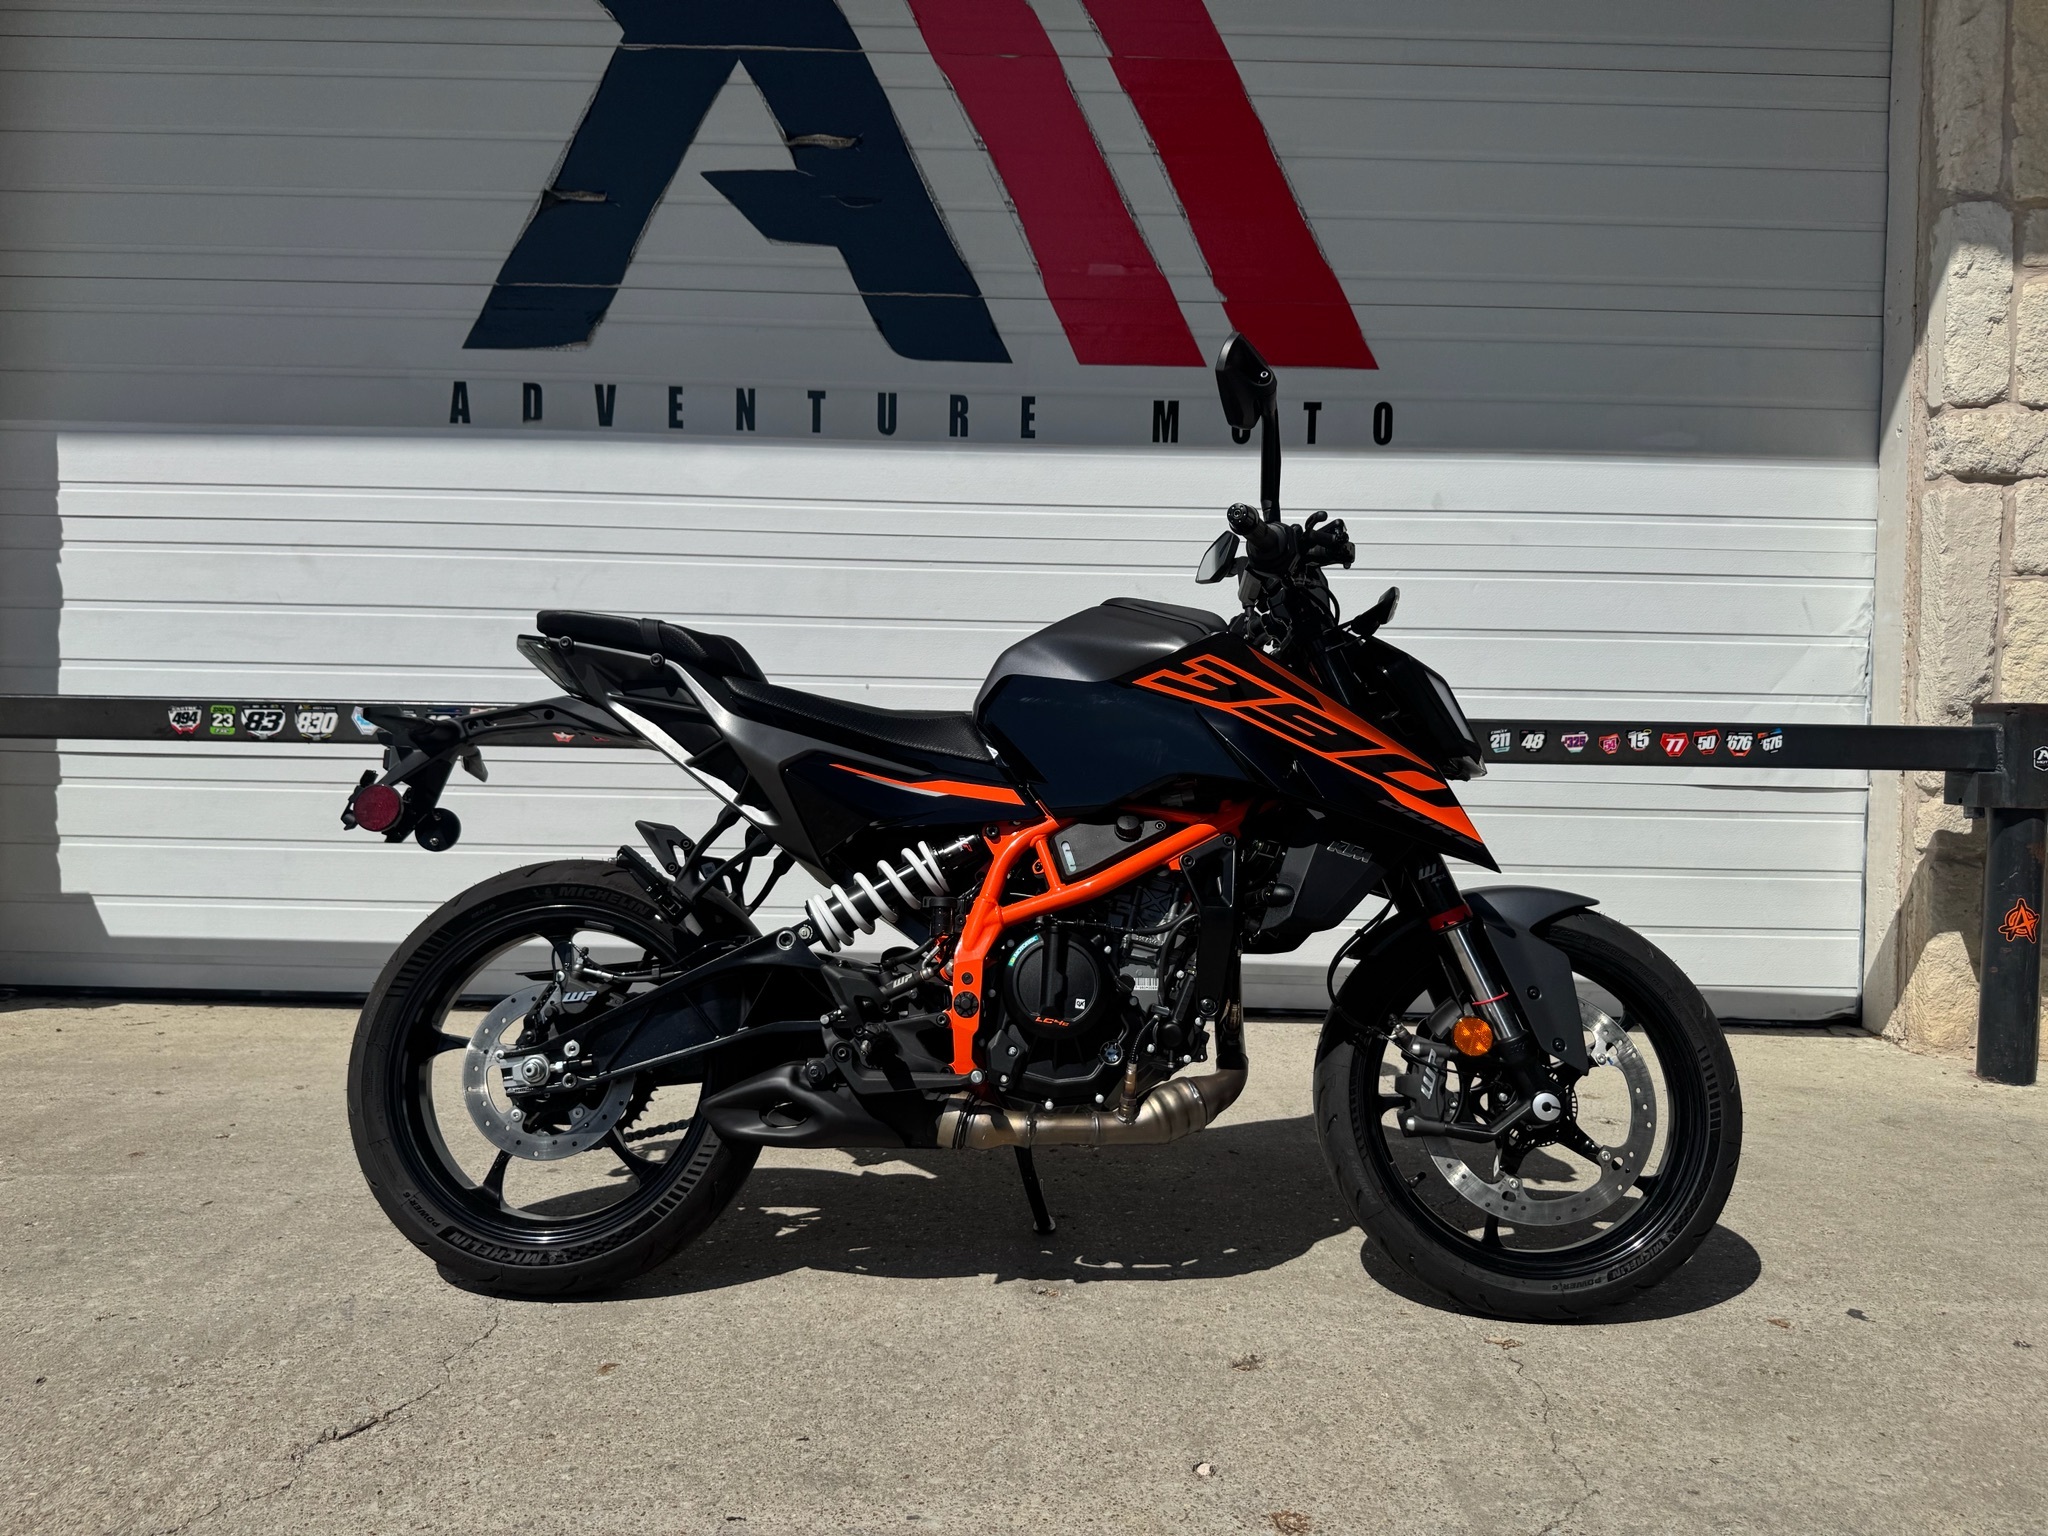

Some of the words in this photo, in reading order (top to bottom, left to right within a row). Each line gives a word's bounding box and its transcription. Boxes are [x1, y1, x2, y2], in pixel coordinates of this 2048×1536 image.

[449, 381, 1038, 440] ADVENTURE
[172, 711, 198, 725] 494
[212, 713, 234, 727] 23
[244, 711, 283, 731] 83
[299, 712, 339, 733] 830
[1490, 732, 1511, 749] 211
[1521, 733, 1545, 749] 48
[1627, 732, 1650, 749] 15
[1666, 738, 1685, 752] 77
[1697, 735, 1717, 751] 50
[1377, 799, 1482, 848] DUKE
[1326, 840, 1373, 863] KTM
[559, 886, 651, 916] MICHELIN
[892, 972, 914, 989] WP
[561, 990, 598, 1003] WP
[1420, 1049, 1437, 1100] WP
[409, 1199, 440, 1228] POWER
[448, 1231, 543, 1264] MICHELIN
[1611, 1240, 1665, 1279] MICHELIN
[1563, 1276, 1602, 1290] POWER
